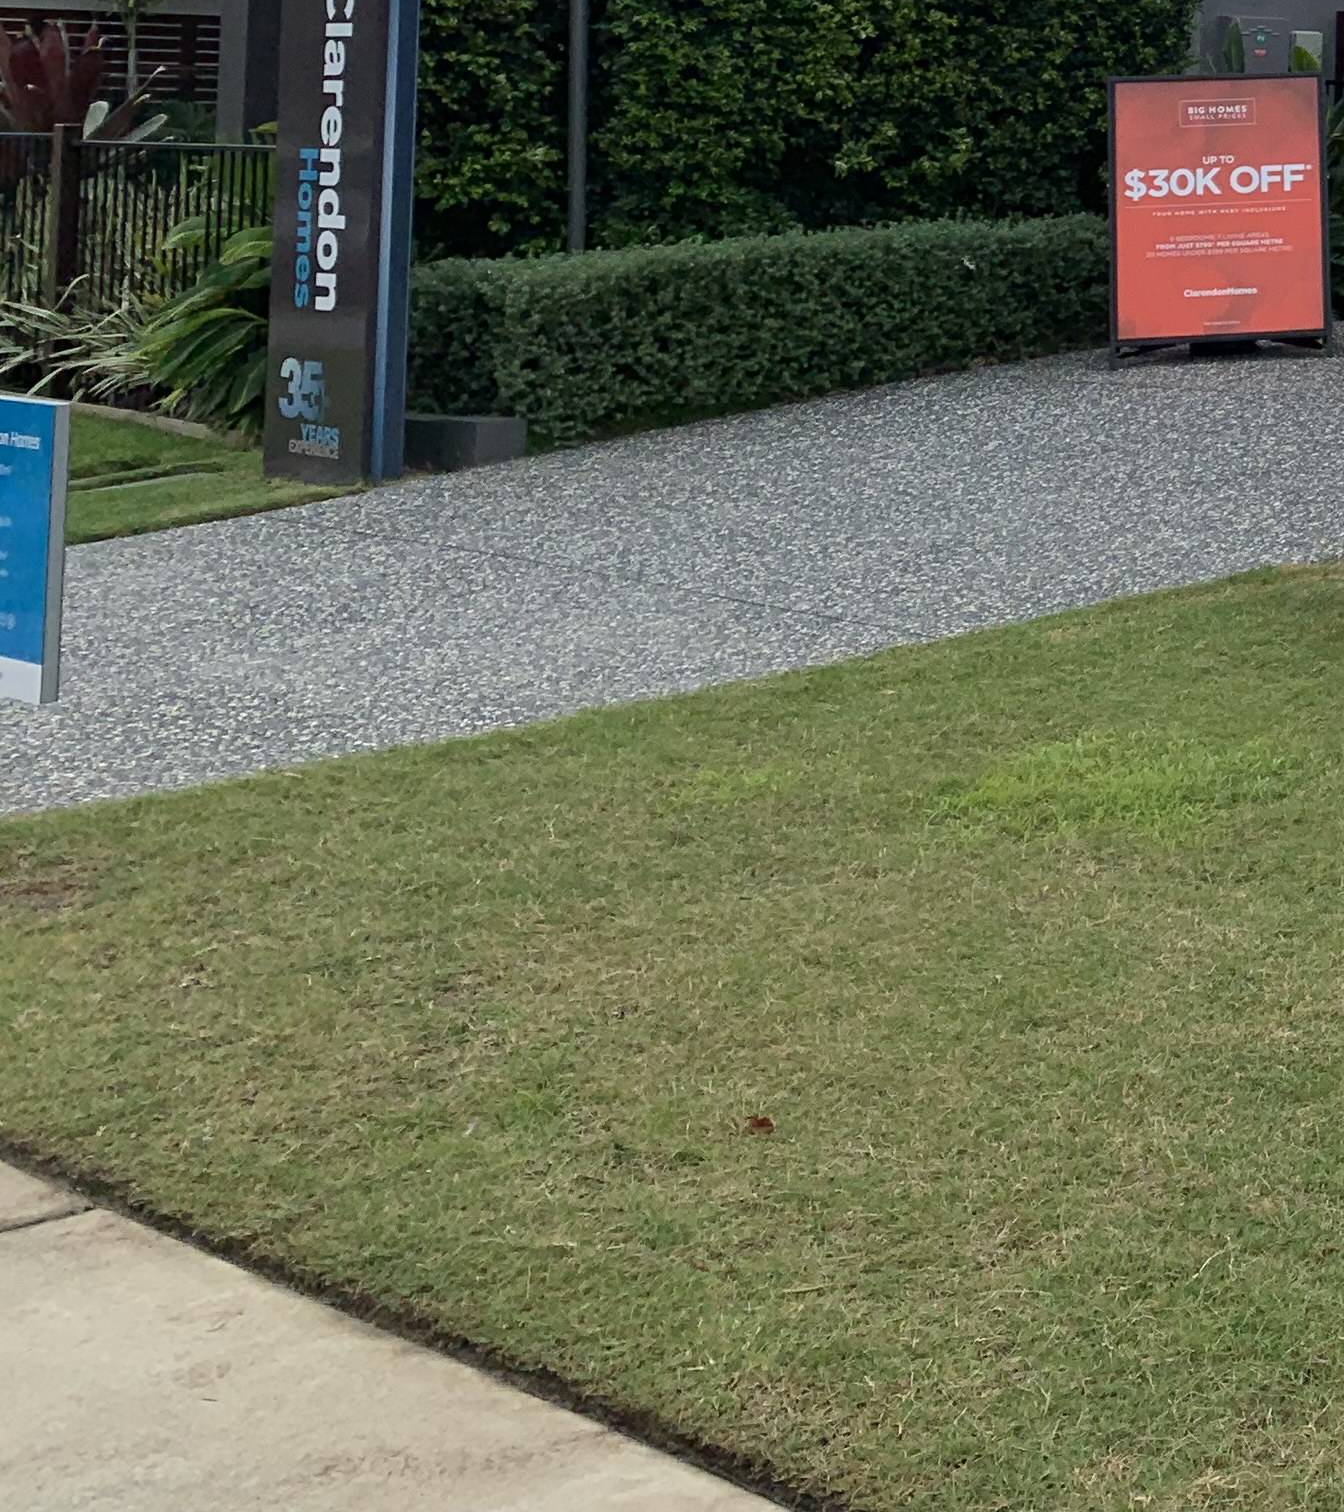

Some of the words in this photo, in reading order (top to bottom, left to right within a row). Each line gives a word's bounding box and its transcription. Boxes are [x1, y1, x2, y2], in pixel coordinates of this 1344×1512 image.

[1188, 106, 1205, 114] BIG
[1208, 105, 1248, 114] HOMES
[1202, 156, 1218, 165] UP
[1219, 155, 1235, 164] TO
[1124, 167, 1222, 201] $30K
[294, 147, 319, 308] Homes
